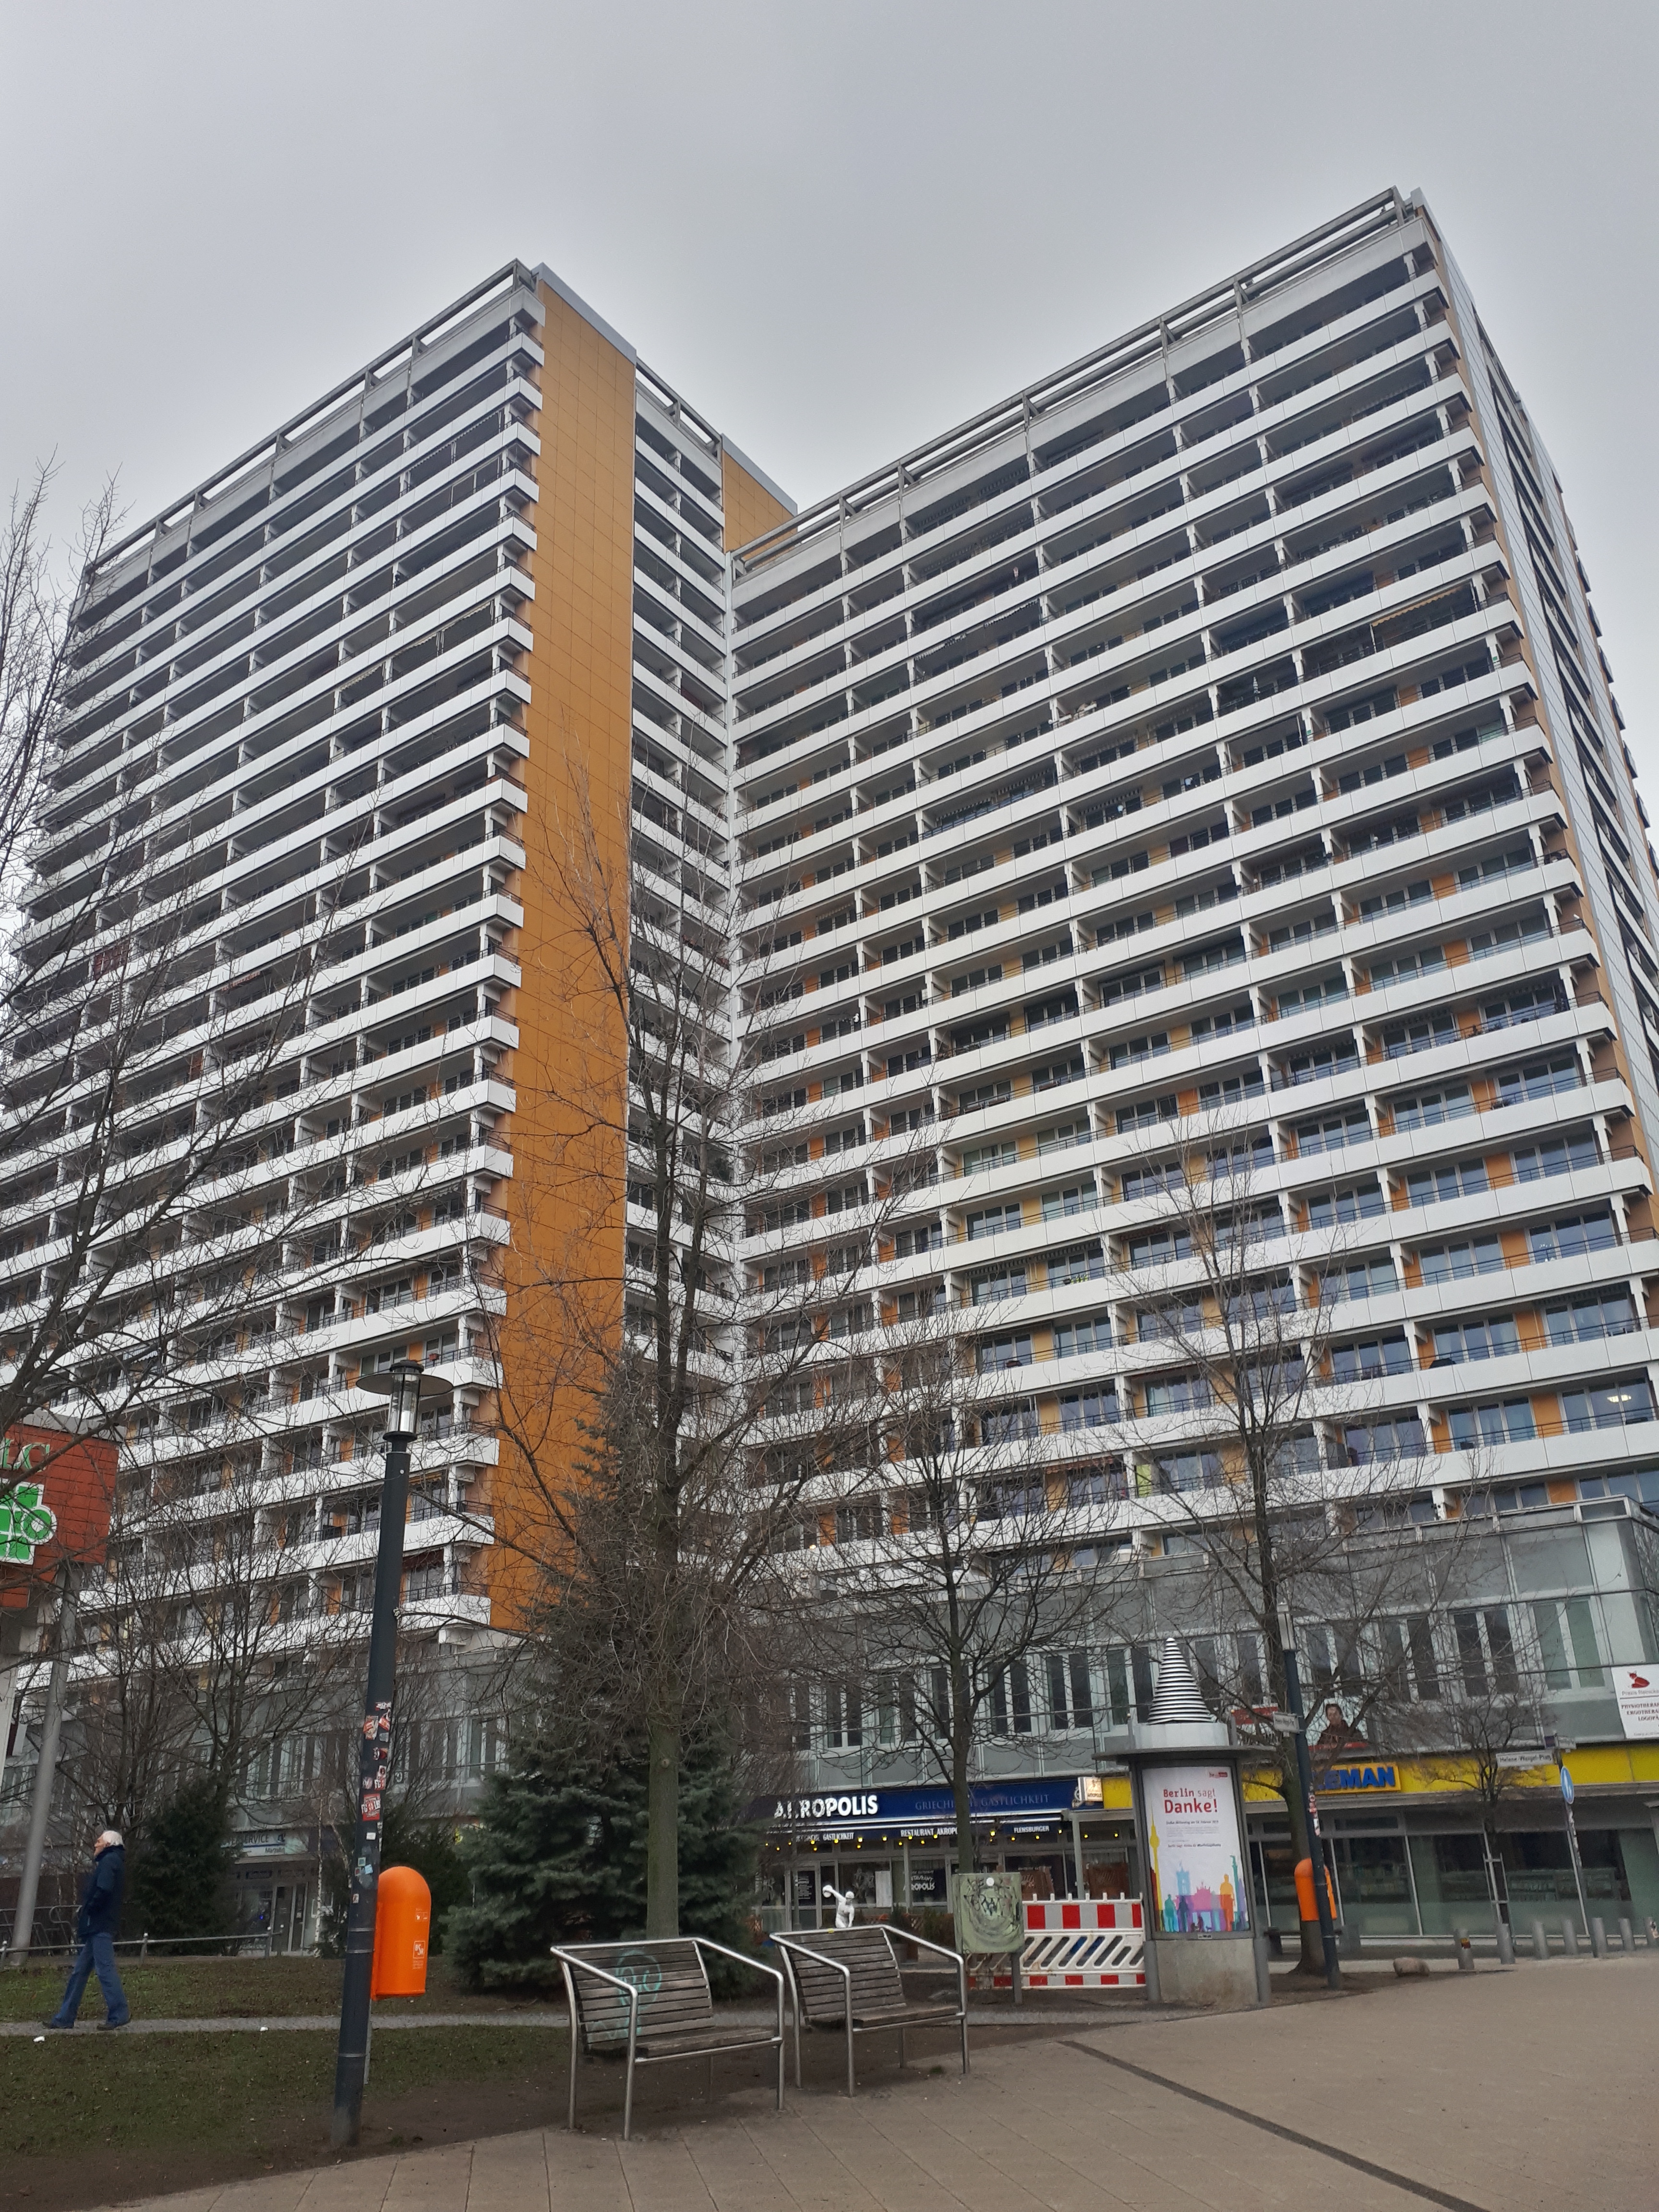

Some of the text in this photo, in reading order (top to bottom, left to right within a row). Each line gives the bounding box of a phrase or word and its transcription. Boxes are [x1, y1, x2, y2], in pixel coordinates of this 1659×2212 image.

[1317, 1766, 1395, 1790] EMAN
[1163, 1788, 1215, 1798] Berlin sagt
[1164, 1798, 1218, 1814] Danke!
[823, 1832, 854, 1840] GASTLICHKEIT
[901, 1827, 934, 1837] RESTAURANT
